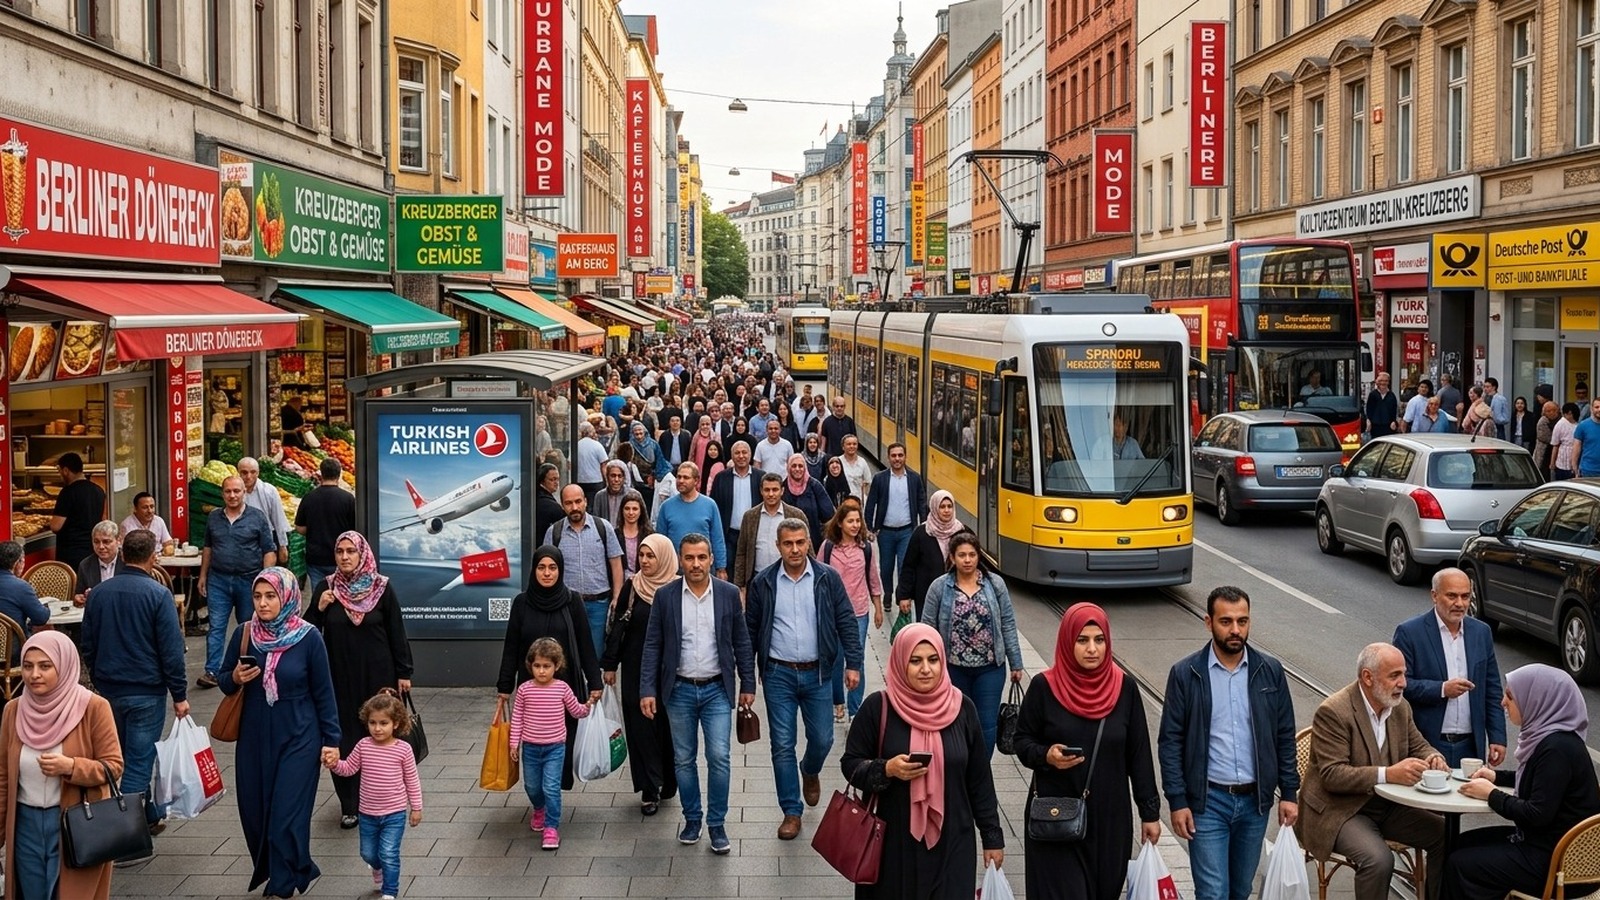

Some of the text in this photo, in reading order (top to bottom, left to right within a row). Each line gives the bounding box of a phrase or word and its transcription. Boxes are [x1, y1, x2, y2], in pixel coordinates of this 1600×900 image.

[535, 0, 553, 190] URBANE MODE
[1200, 28, 1216, 181] BERLINERE
[1104, 148, 1123, 219] MODE
[36, 158, 216, 249] BERLINER DÖNERECK
[402, 204, 497, 219] KREUZBERGER
[1300, 204, 1367, 234] KULTURZENTRUM
[290, 225, 326, 256] OBST
[329, 231, 338, 257] &
[421, 225, 478, 242] OBST &
[416, 244, 482, 265] GEMÜSE
[1495, 239, 1563, 257] Deutsche Post
[566, 258, 582, 269] AM
[390, 425, 470, 439] TURKISH
[389, 441, 471, 455] AIRLINES
